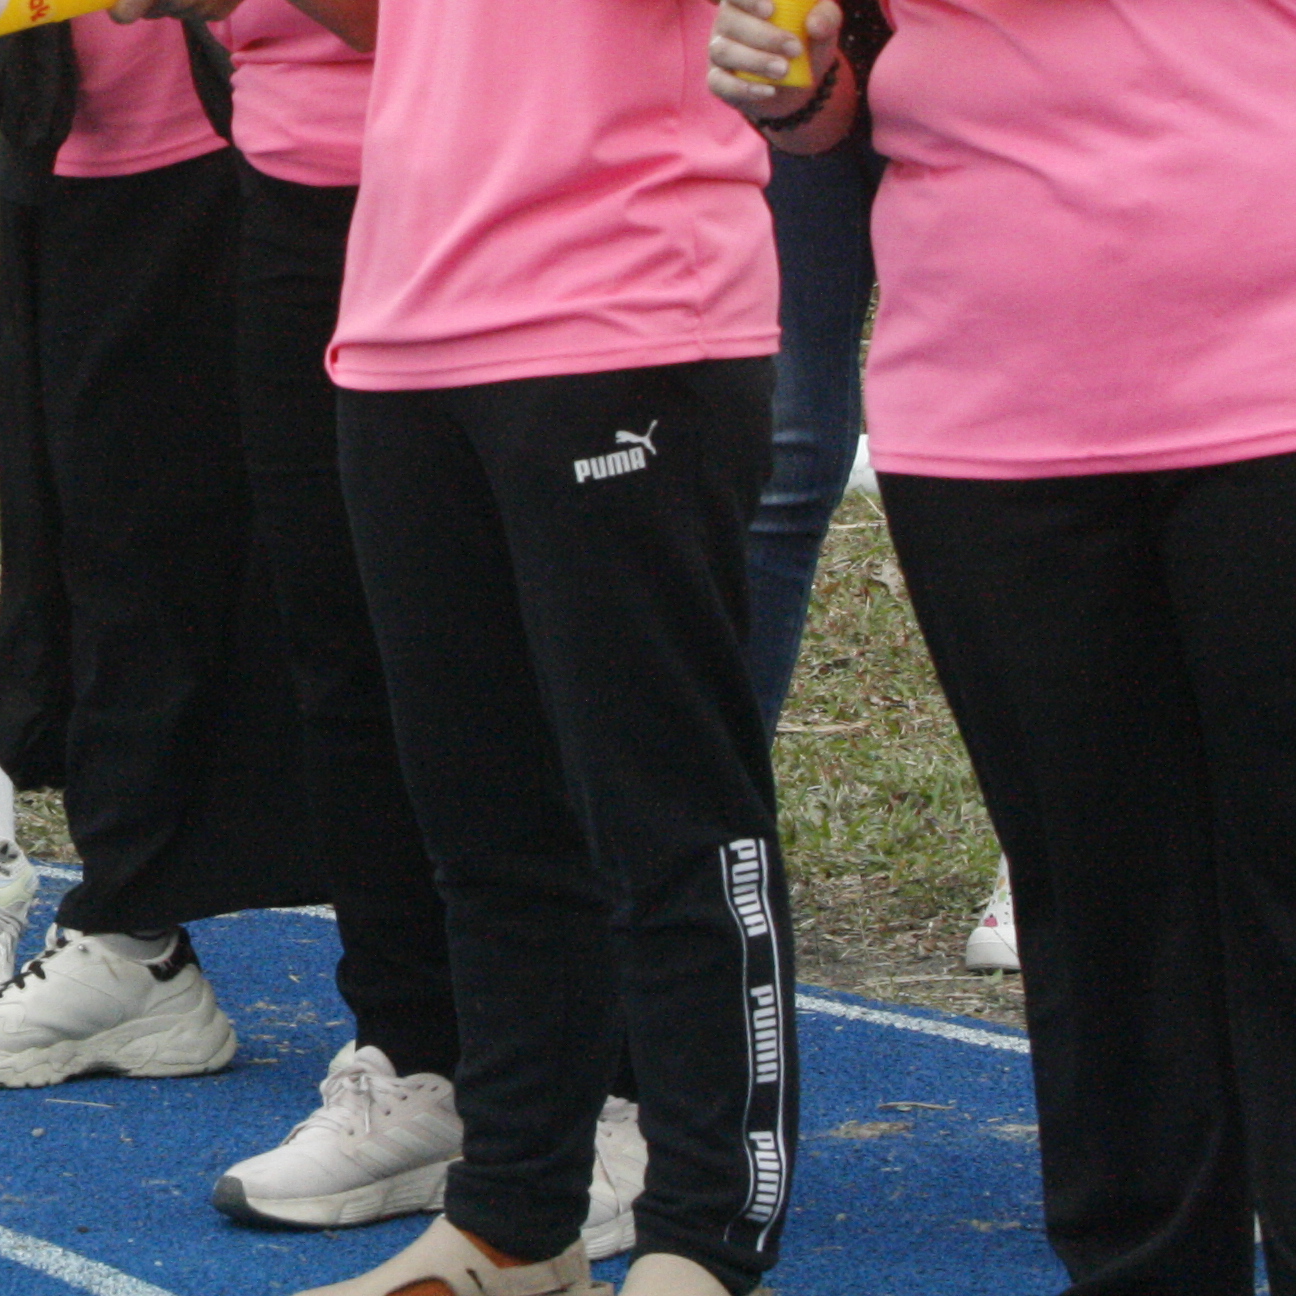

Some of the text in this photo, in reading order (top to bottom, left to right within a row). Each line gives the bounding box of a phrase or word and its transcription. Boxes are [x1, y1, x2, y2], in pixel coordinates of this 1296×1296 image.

[574, 446, 646, 483] PUMA
[729, 838, 768, 937] PUMA
[750, 984, 778, 1084] PUMA
[745, 1131, 780, 1222] PUMA
